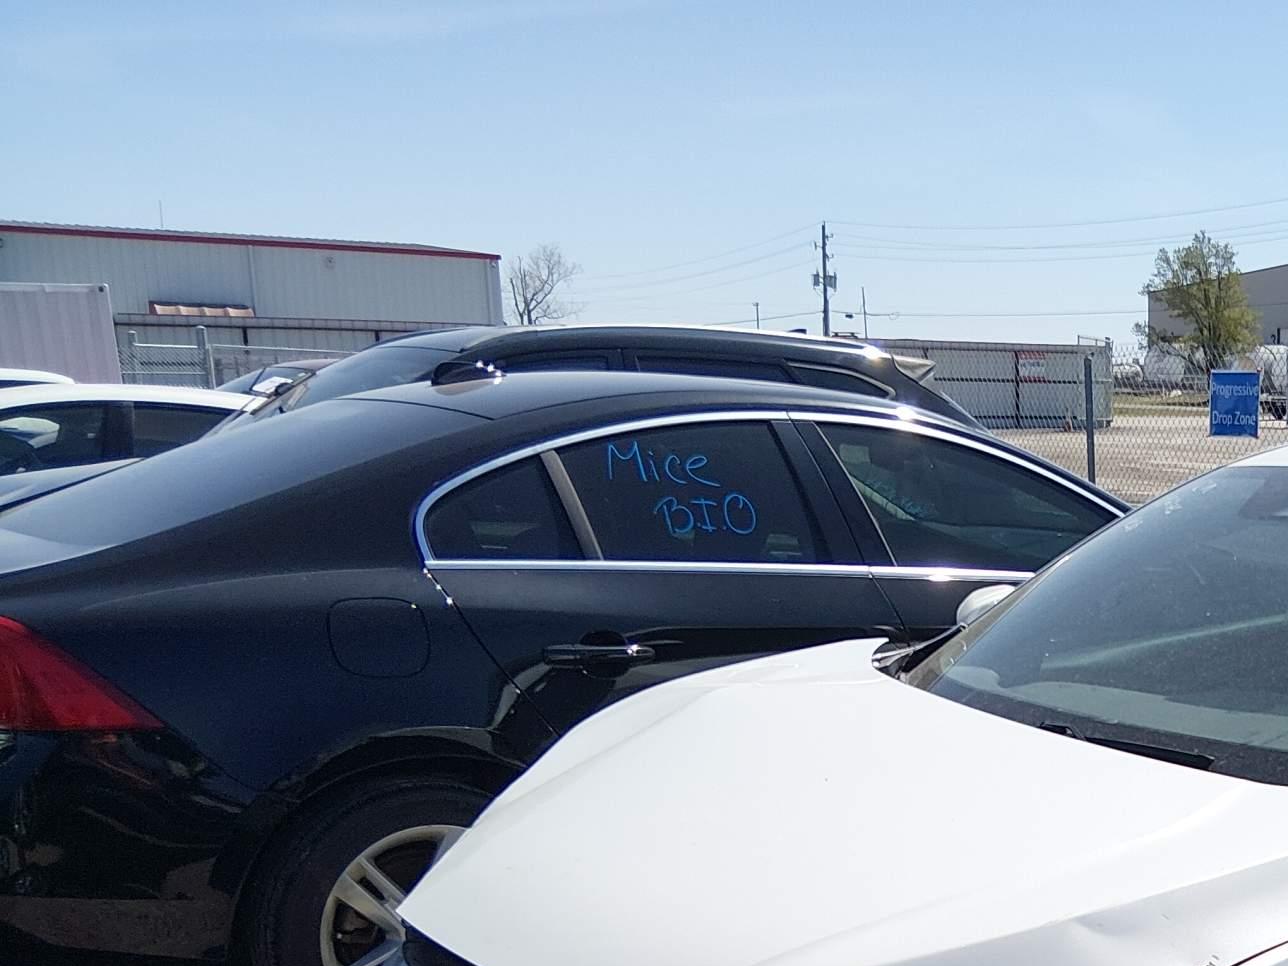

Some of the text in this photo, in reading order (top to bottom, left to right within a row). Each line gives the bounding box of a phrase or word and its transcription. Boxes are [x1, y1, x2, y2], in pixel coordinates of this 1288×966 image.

[1211, 382, 1259, 399] Progressive
[1212, 410, 1256, 428] Drop Zone
[608, 441, 721, 487] Mice
